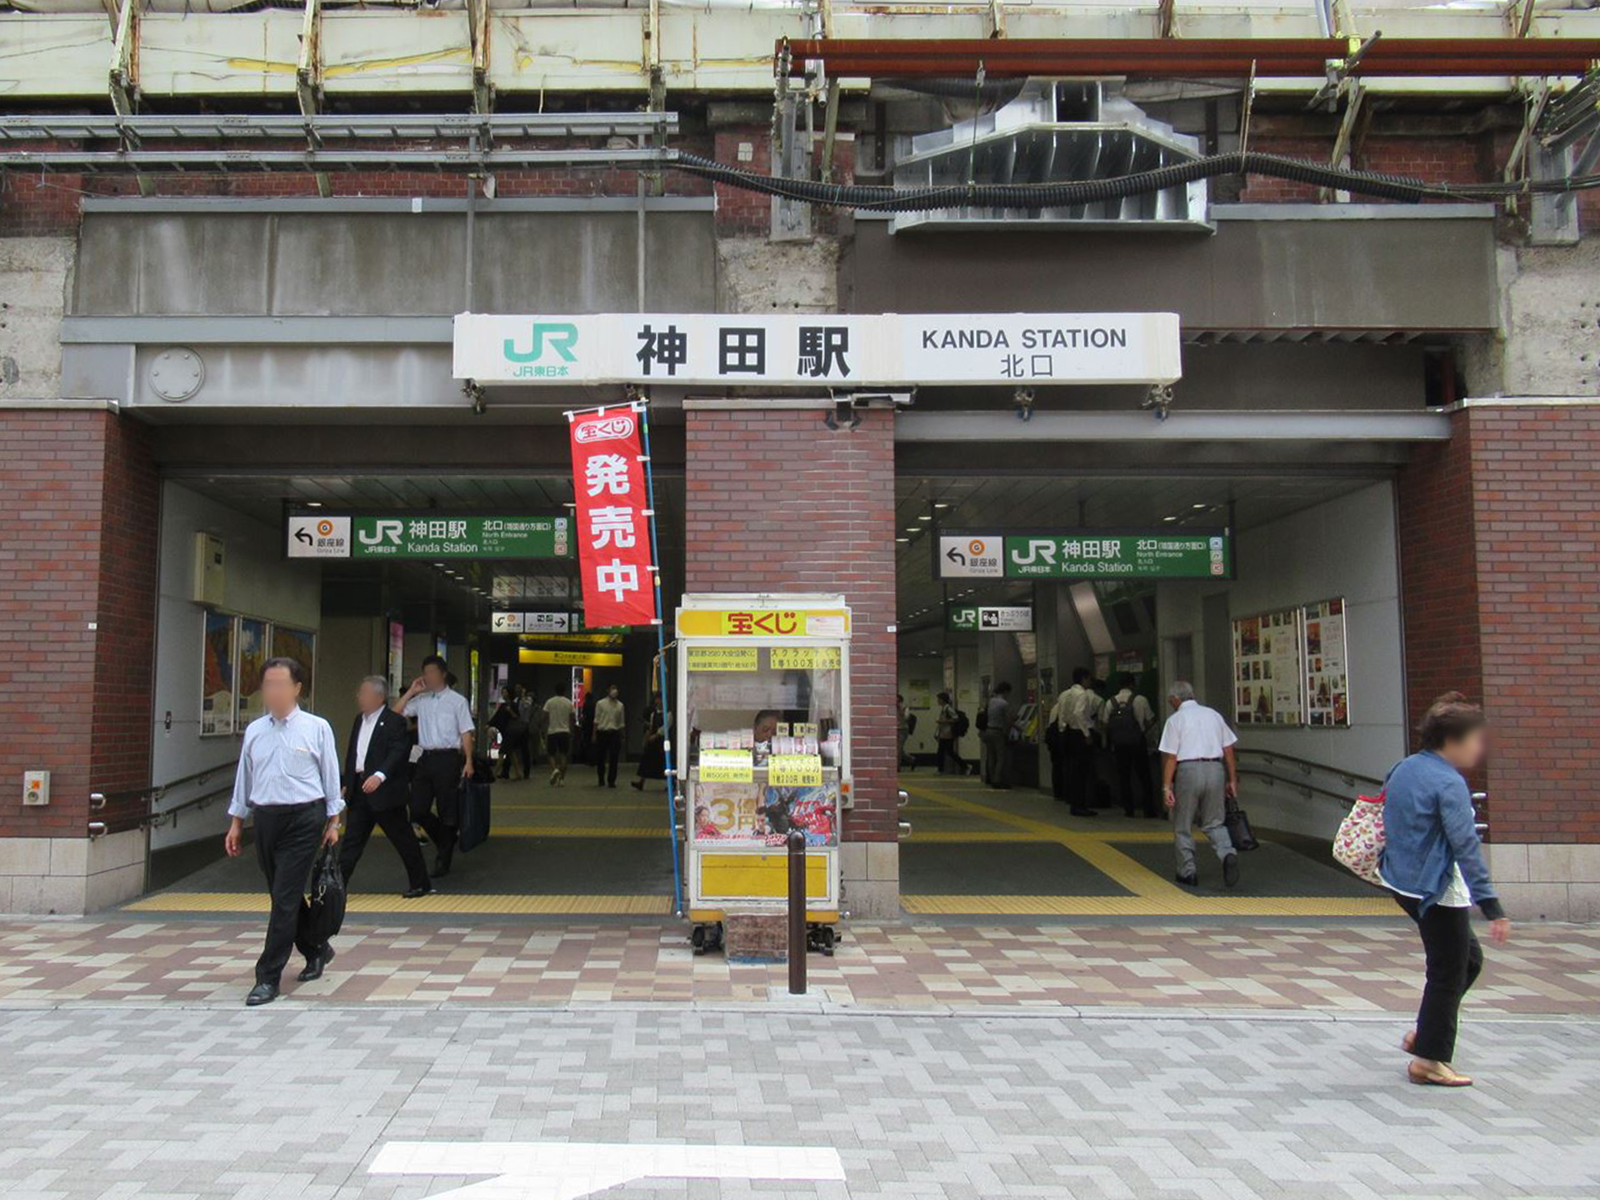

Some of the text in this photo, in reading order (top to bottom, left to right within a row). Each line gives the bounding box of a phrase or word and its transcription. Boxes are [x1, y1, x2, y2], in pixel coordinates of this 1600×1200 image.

[504, 323, 579, 363] JR
[922, 328, 1127, 349] KANDA STATION
[636, 324, 852, 377] 神田駅
[513, 365, 570, 377] JR東日本
[1000, 354, 1053, 378] 北口
[581, 419, 627, 439] 宝くじ
[359, 520, 403, 545] JR
[409, 520, 467, 539] 神田駅
[585, 453, 639, 602] 発売中
[407, 542, 440, 553] Kanda
[442, 542, 478, 553] Station
[1012, 540, 1057, 564] JR
[1061, 540, 1121, 559] 神田駅
[970, 558, 998, 567] 銀座線
[1061, 562, 1096, 573] Kanda
[1097, 561, 1133, 572] Station
[728, 612, 797, 634] 宝くじ
[953, 610, 976, 623] JR
